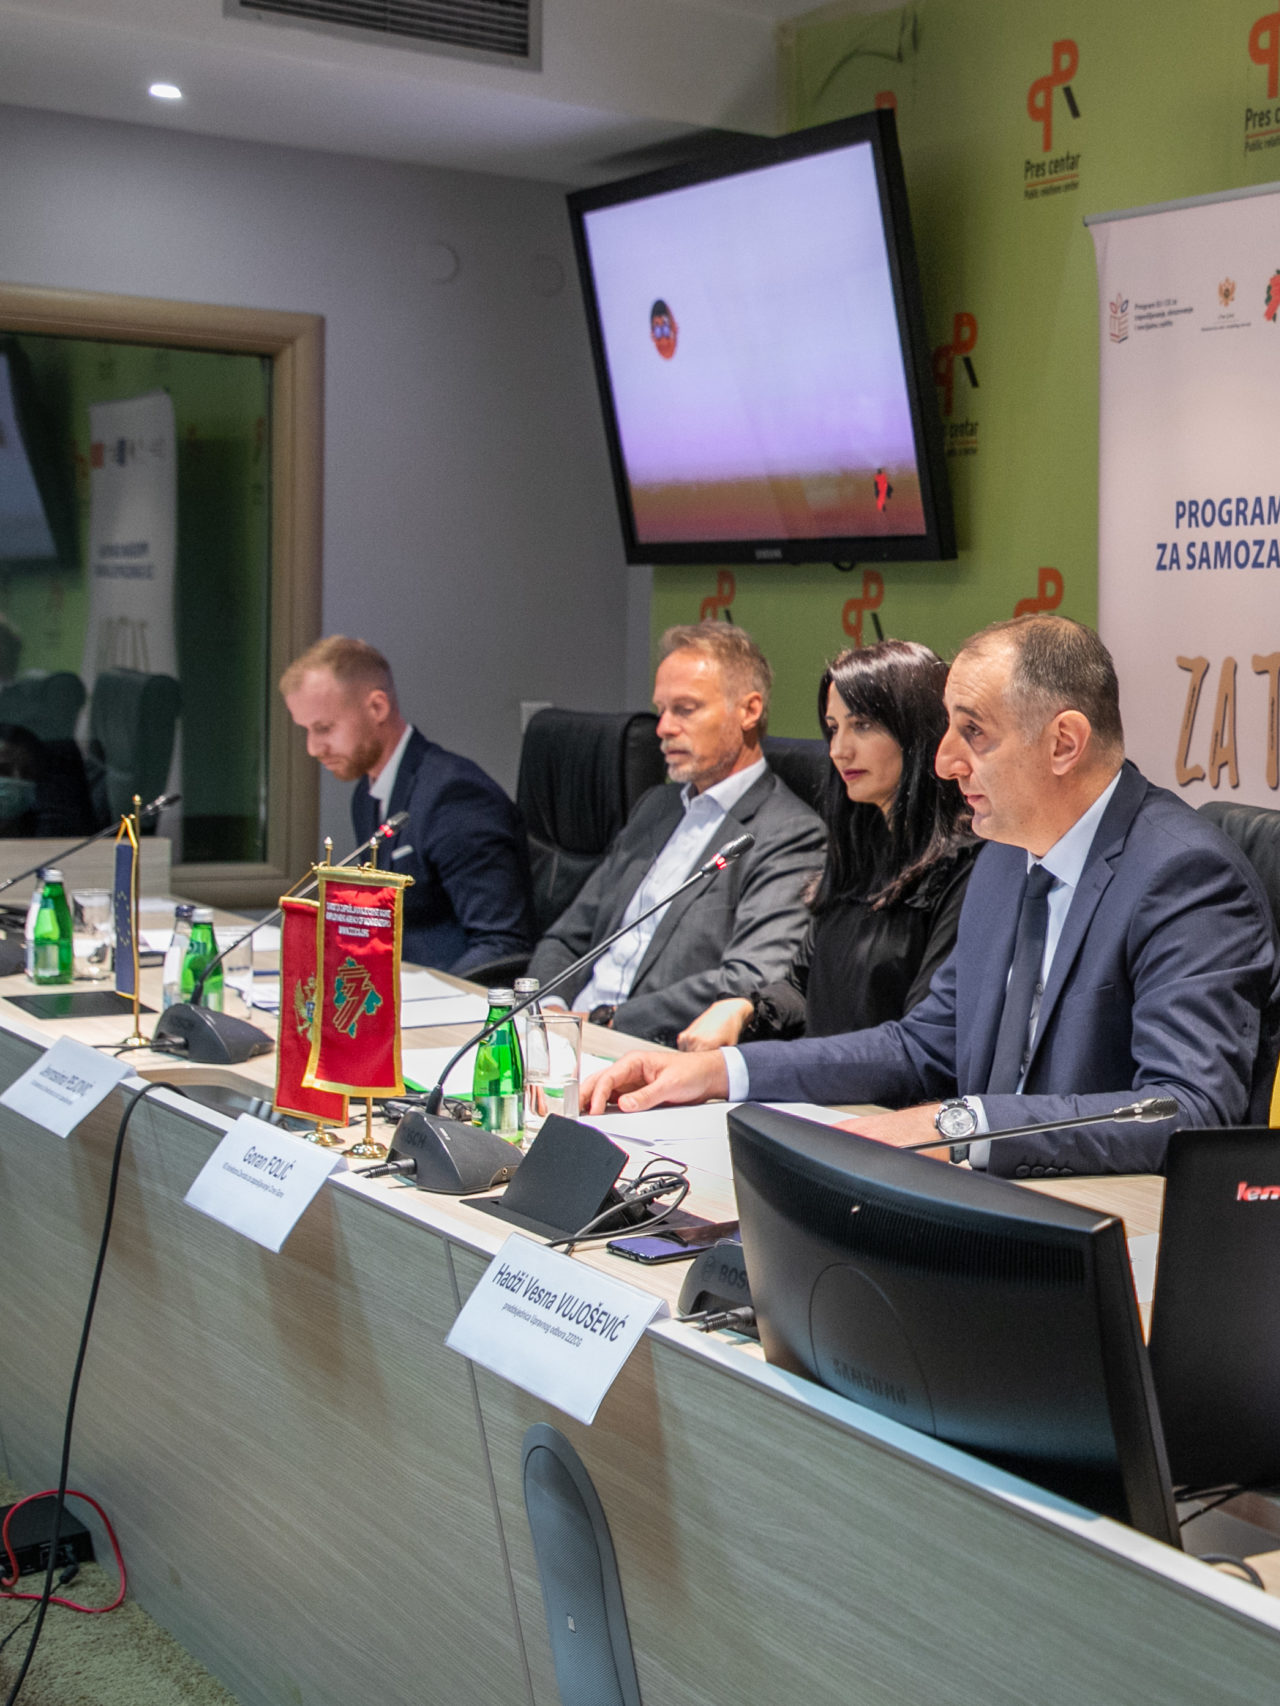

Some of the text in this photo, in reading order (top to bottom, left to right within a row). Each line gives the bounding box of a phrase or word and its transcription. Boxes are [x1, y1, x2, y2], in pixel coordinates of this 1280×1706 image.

[1245, 108, 1271, 131] Pres
[1155, 542, 1181, 571] ZA
[1175, 655, 1240, 789] ZA
[718, 1264, 747, 1290] BOS
[492, 1262, 630, 1342] Hadži Vesna VUJOŠEVIĆ
